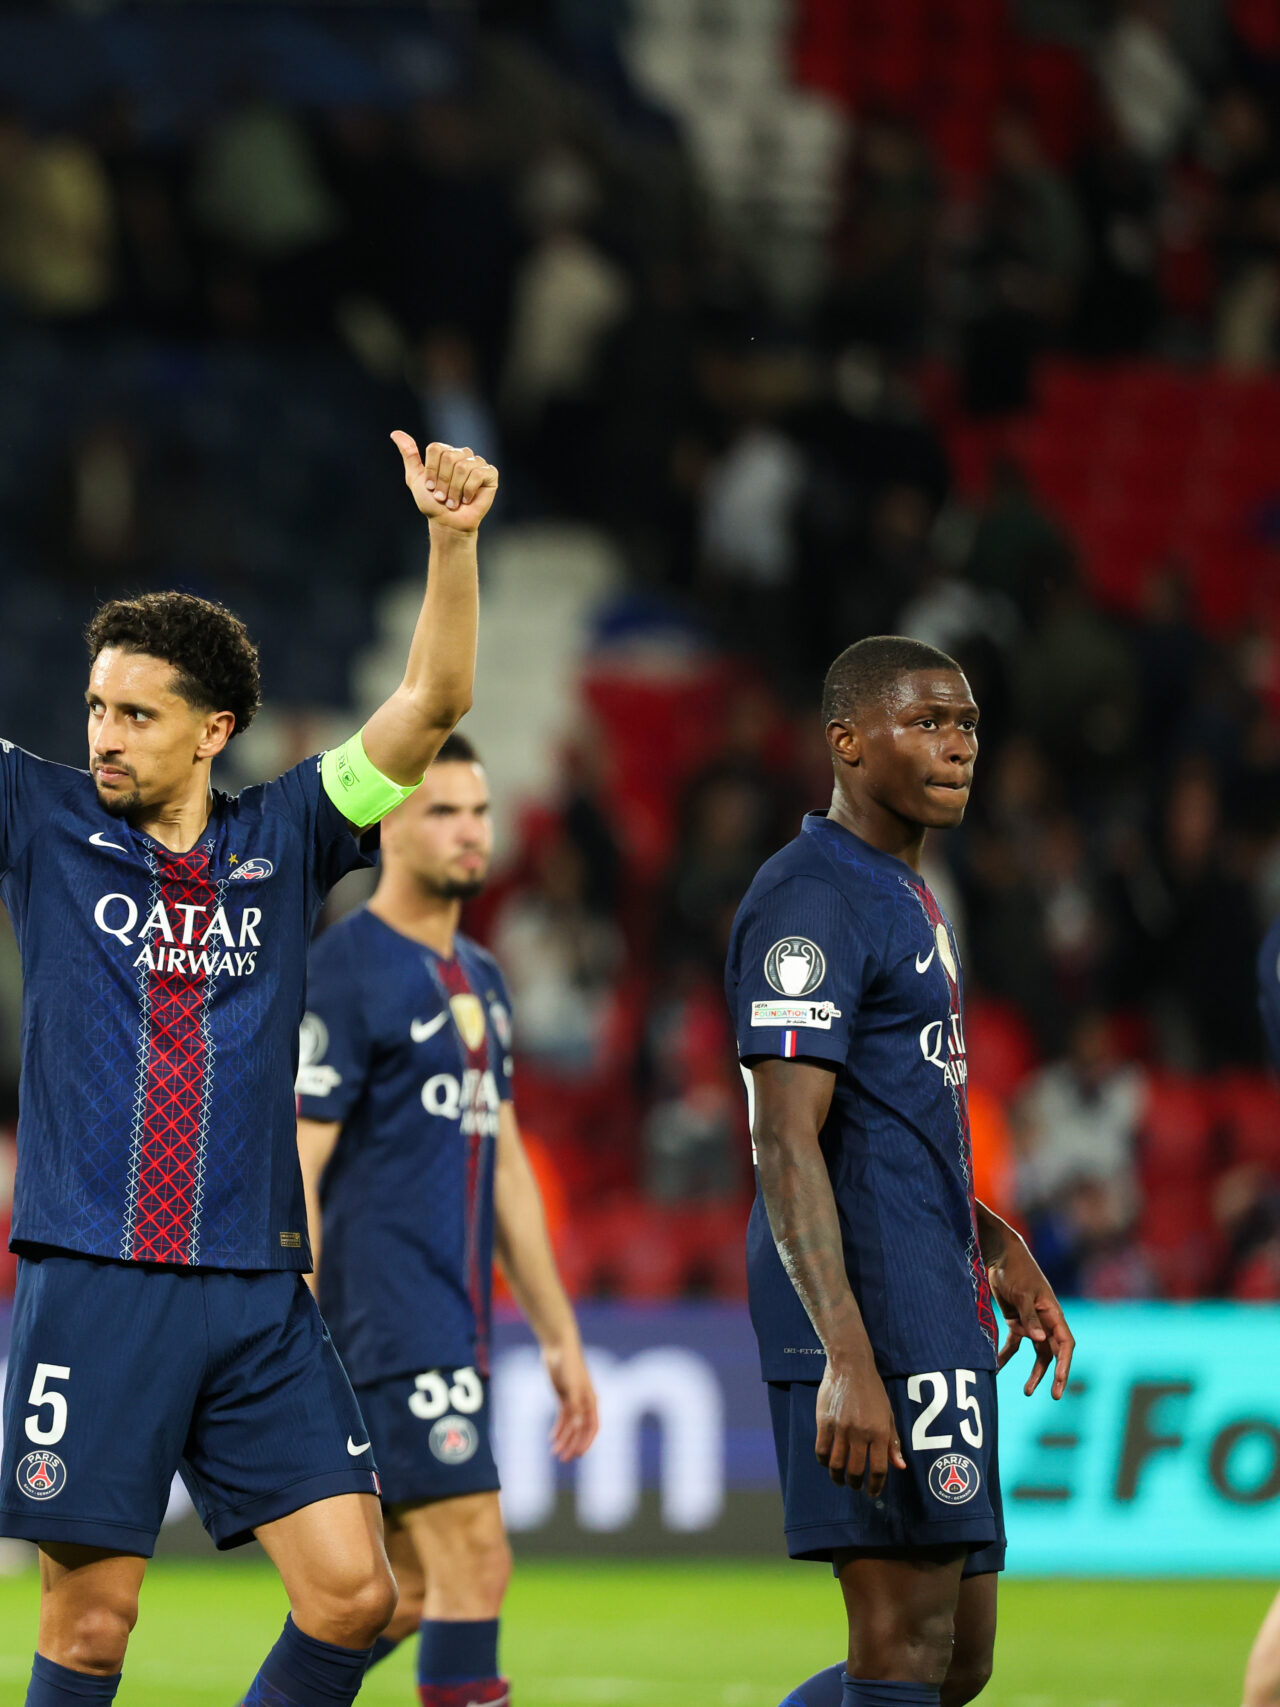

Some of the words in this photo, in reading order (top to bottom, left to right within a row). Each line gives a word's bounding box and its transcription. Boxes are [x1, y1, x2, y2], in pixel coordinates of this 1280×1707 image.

[93, 892, 262, 947] QATAR
[133, 944, 258, 977] AIRWAYS
[24, 1362, 71, 1446] 5
[907, 1368, 984, 1451] 25
[27, 1453, 60, 1468] PARIS
[936, 1456, 970, 1470] PARIS
